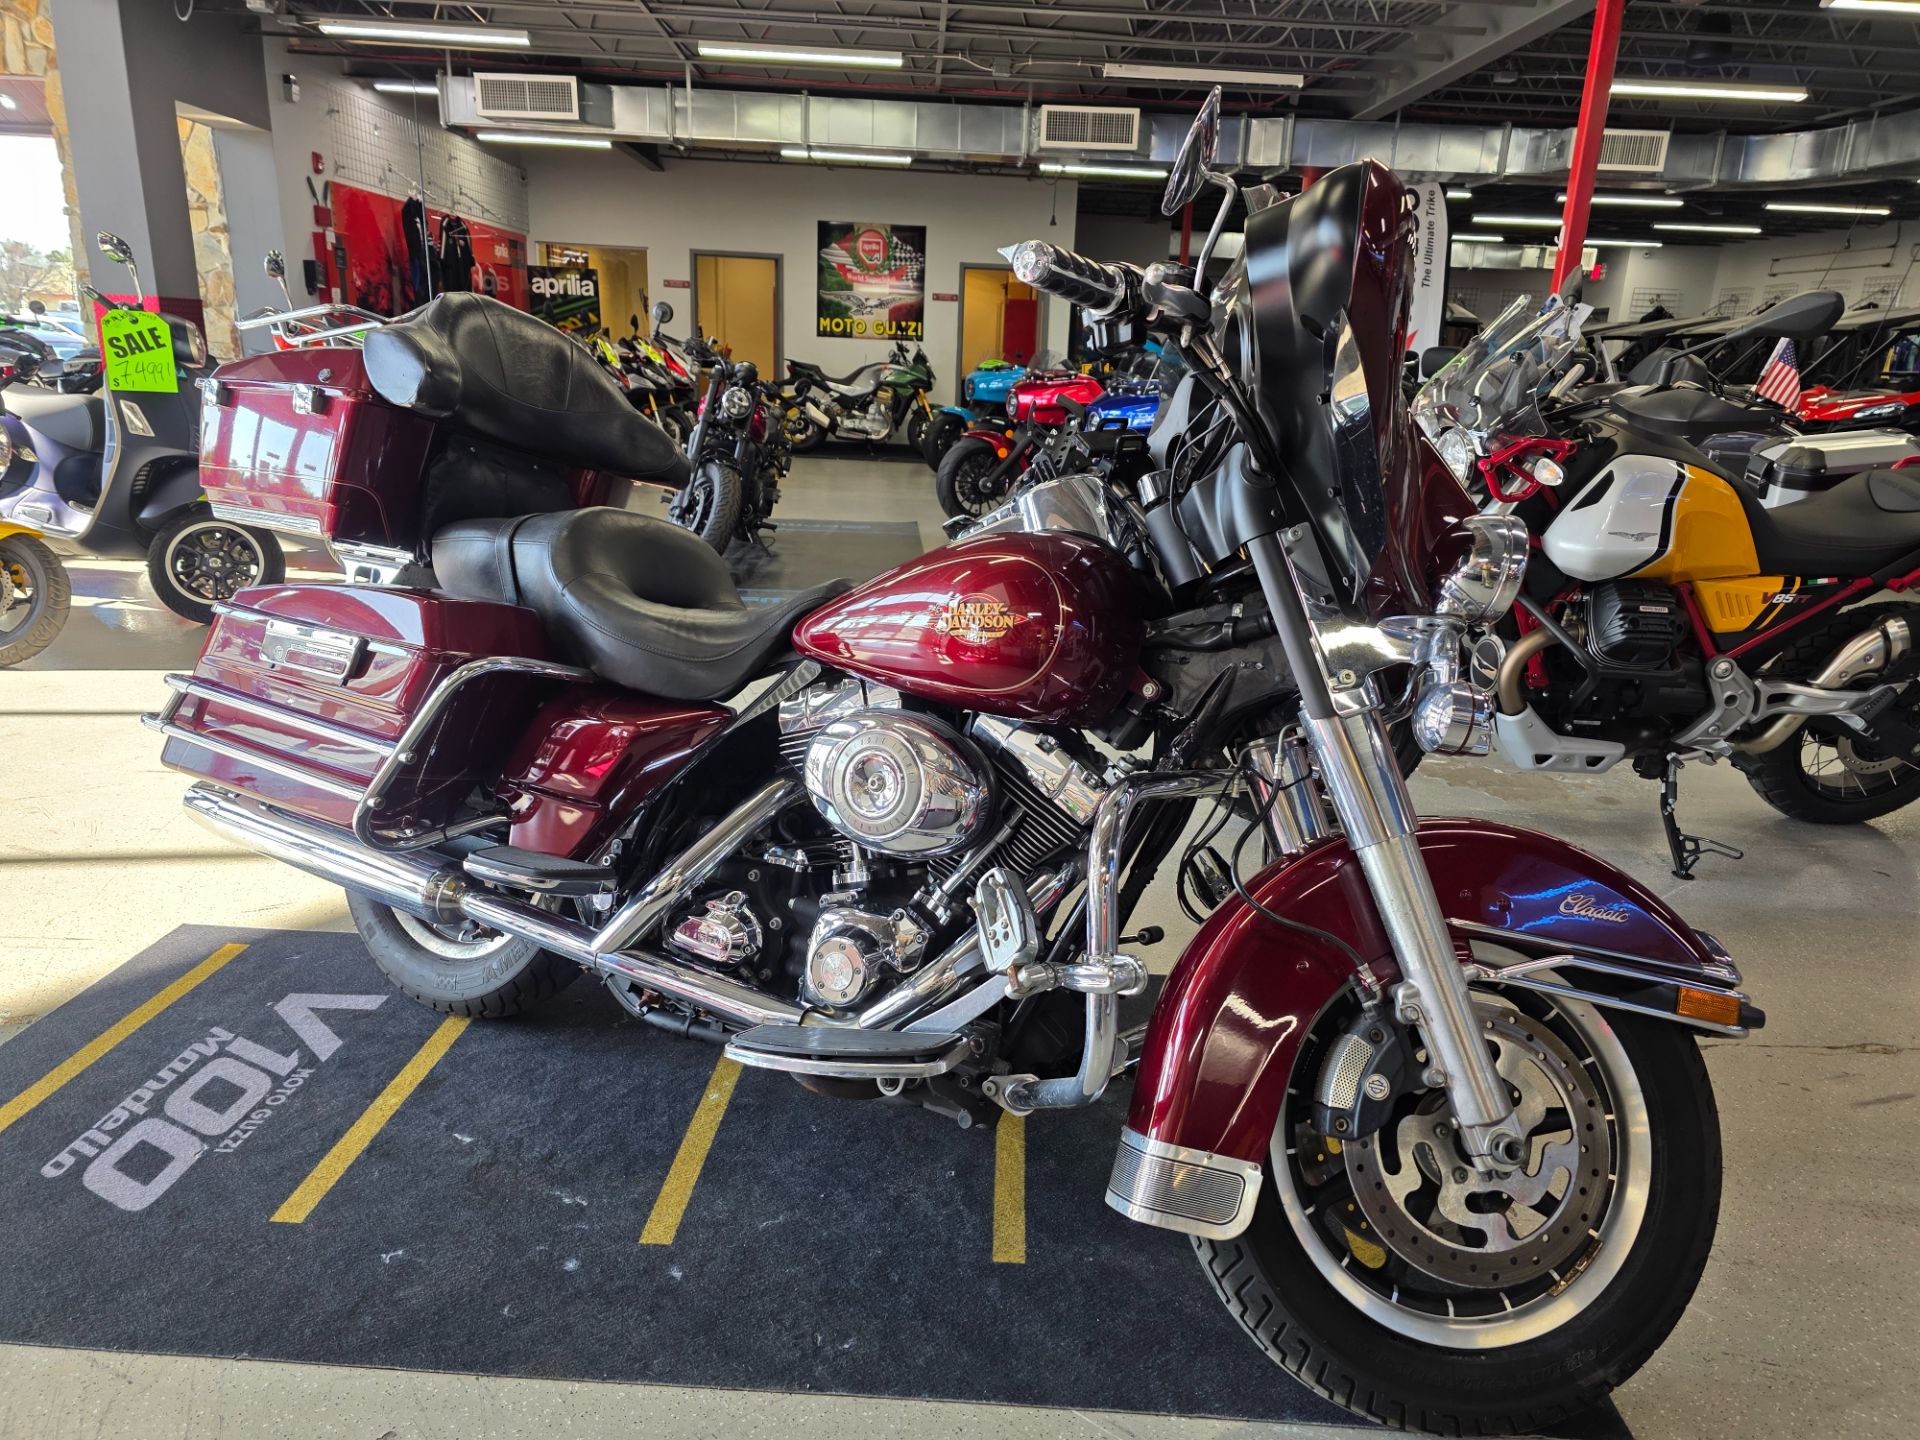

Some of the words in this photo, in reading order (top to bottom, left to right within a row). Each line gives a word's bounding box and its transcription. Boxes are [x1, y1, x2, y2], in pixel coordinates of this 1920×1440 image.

[1425, 189, 1436, 217] Trike
[1423, 220, 1435, 266] Ultimate
[531, 273, 595, 299] aprilia
[1421, 268, 1432, 288] The
[820, 317, 867, 334] MOTO
[107, 326, 167, 359] SALE
[1559, 893, 1630, 923] Classic
[40, 1026, 235, 1178] Mandello
[82, 992, 390, 1212] V100
[265, 1068, 316, 1107] MOTO
[213, 1108, 273, 1153] GUZZI
